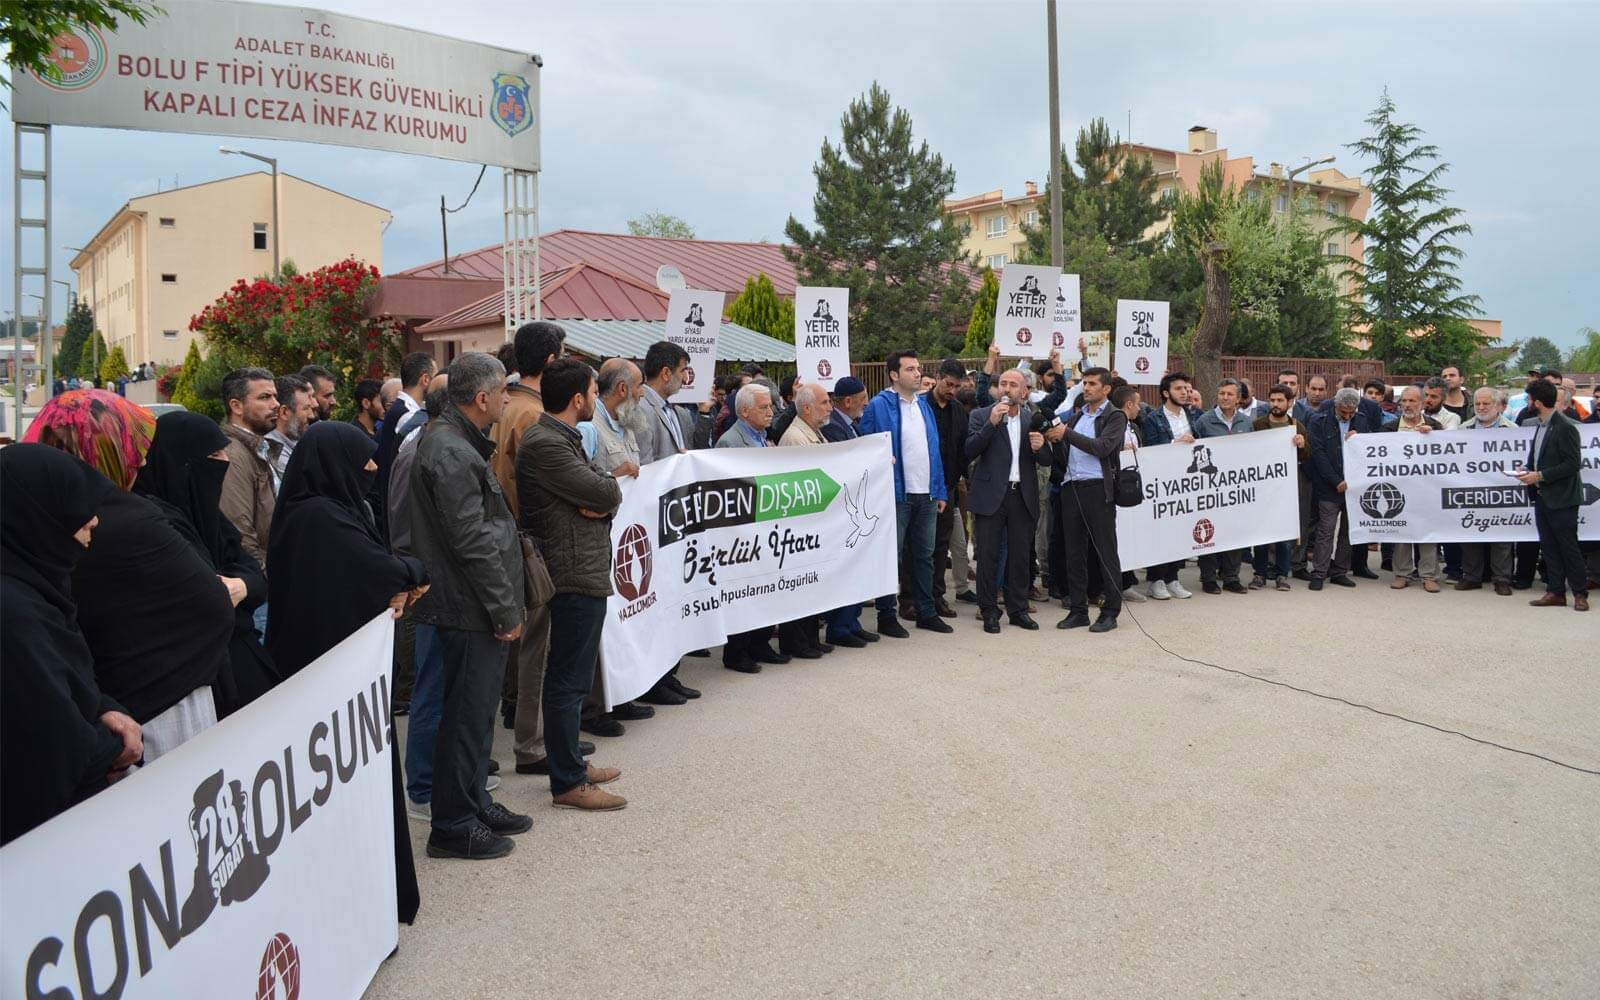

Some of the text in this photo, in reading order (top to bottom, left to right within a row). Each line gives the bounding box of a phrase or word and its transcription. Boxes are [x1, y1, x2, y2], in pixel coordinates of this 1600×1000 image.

[305, 21, 336, 38] T.C.
[234, 37, 395, 70] ADALET BAKANLIĞI
[117, 54, 483, 118] BOLU F TİPİ YÜKSEK GÜVENLİKLİ
[144, 90, 467, 144] KAPALI CEZA İNFAZ KURUMU
[1009, 292, 1047, 305] YETER
[1006, 305, 1046, 319] ARTIK!
[1131, 311, 1154, 322] SON
[805, 319, 840, 333] YETER
[805, 335, 840, 348] ARTIK!
[1123, 336, 1160, 348] OLSUN
[1366, 446, 1388, 458] 28
[1403, 442, 1468, 460] ŞUBAT
[1367, 462, 1460, 478] ZİNDANDA
[1466, 459, 1505, 473] SON
[1162, 475, 1204, 497] YARGI
[1208, 462, 1288, 488] KARARLARI
[759, 478, 822, 517] DIŞARI
[1153, 486, 1256, 520] İPTAL EDİLSİN!
[1448, 488, 1525, 509] İÇERİDEN
[1461, 511, 1532, 532] Özgürlük
[768, 523, 821, 570] İftarı
[778, 570, 819, 592] Özgürlük
[252, 674, 391, 857] OLSUN!
[200, 783, 239, 875] 28
